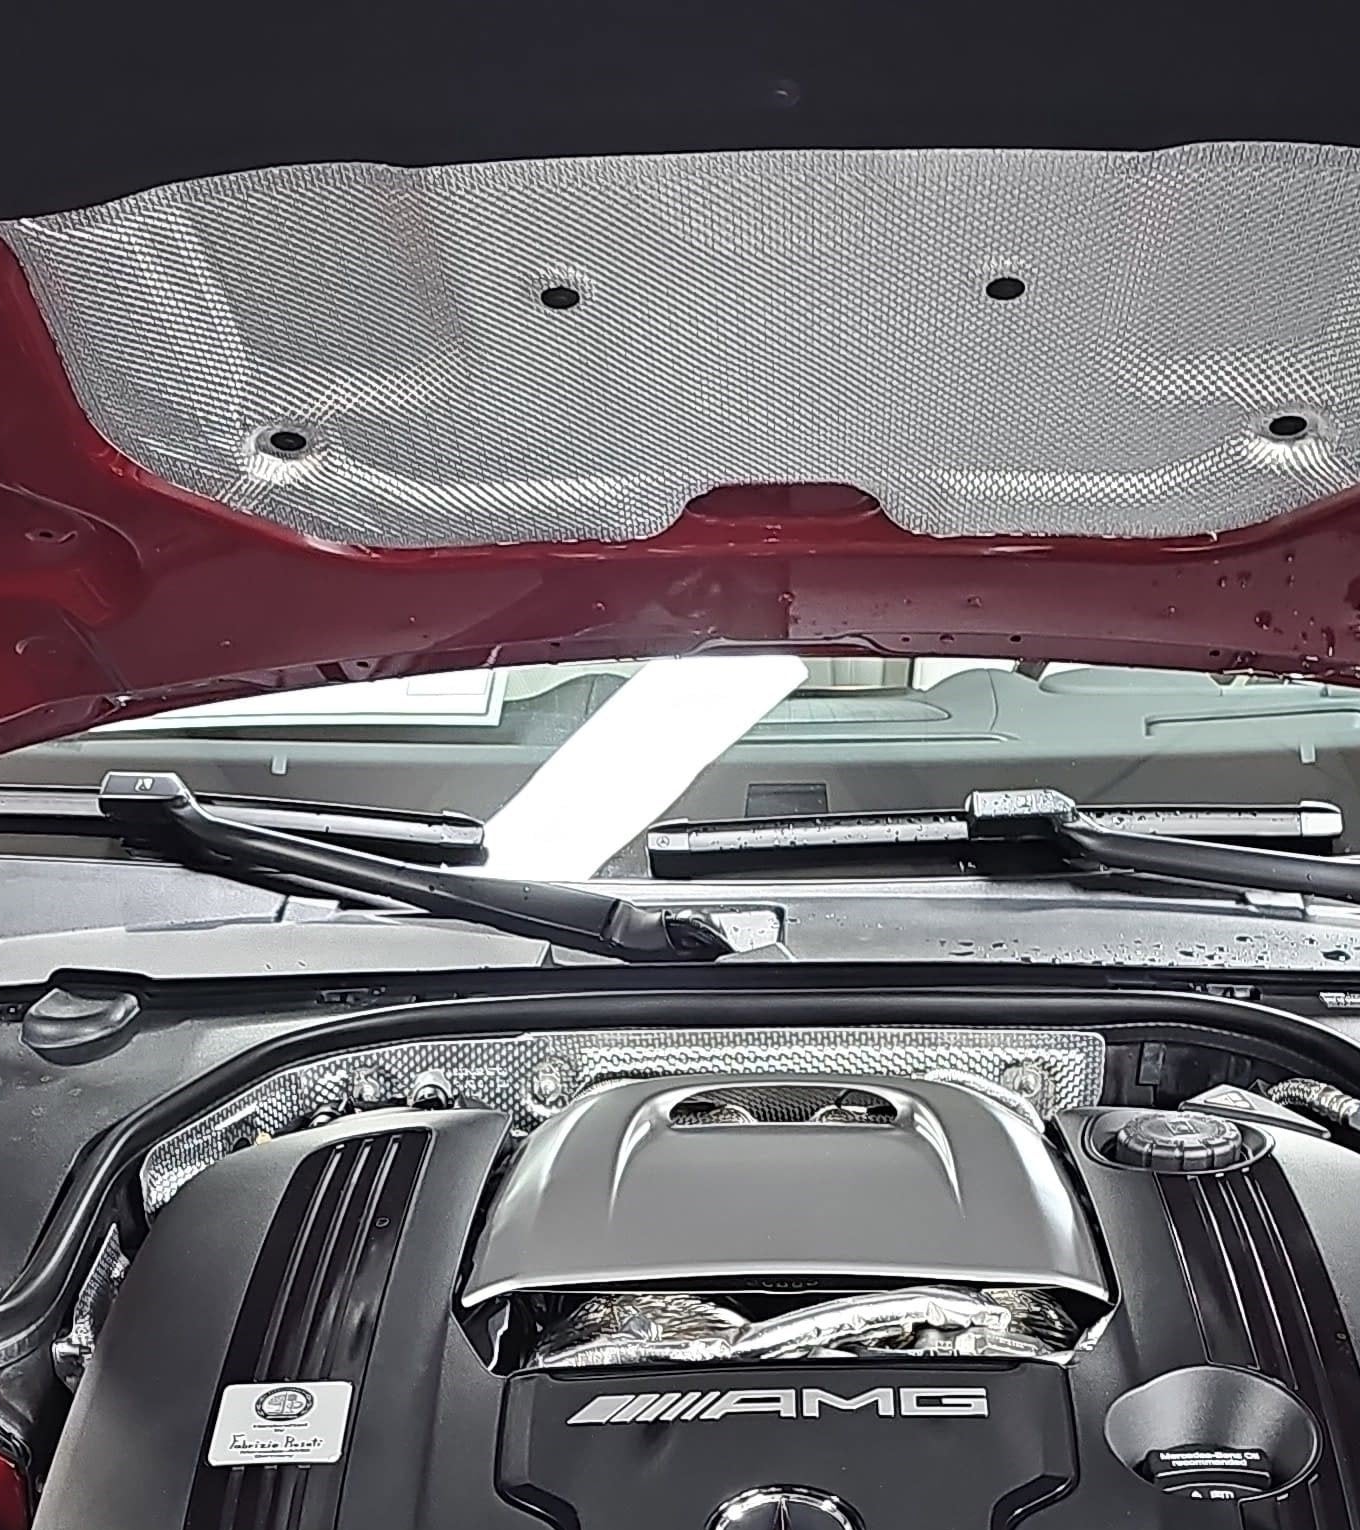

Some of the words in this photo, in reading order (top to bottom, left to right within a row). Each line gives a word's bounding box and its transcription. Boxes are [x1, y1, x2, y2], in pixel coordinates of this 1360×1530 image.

[699, 1388, 989, 1419] AMG
[1159, 1451, 1242, 1460] Mercedes-Benz
[1171, 1459, 1248, 1467] recommended
